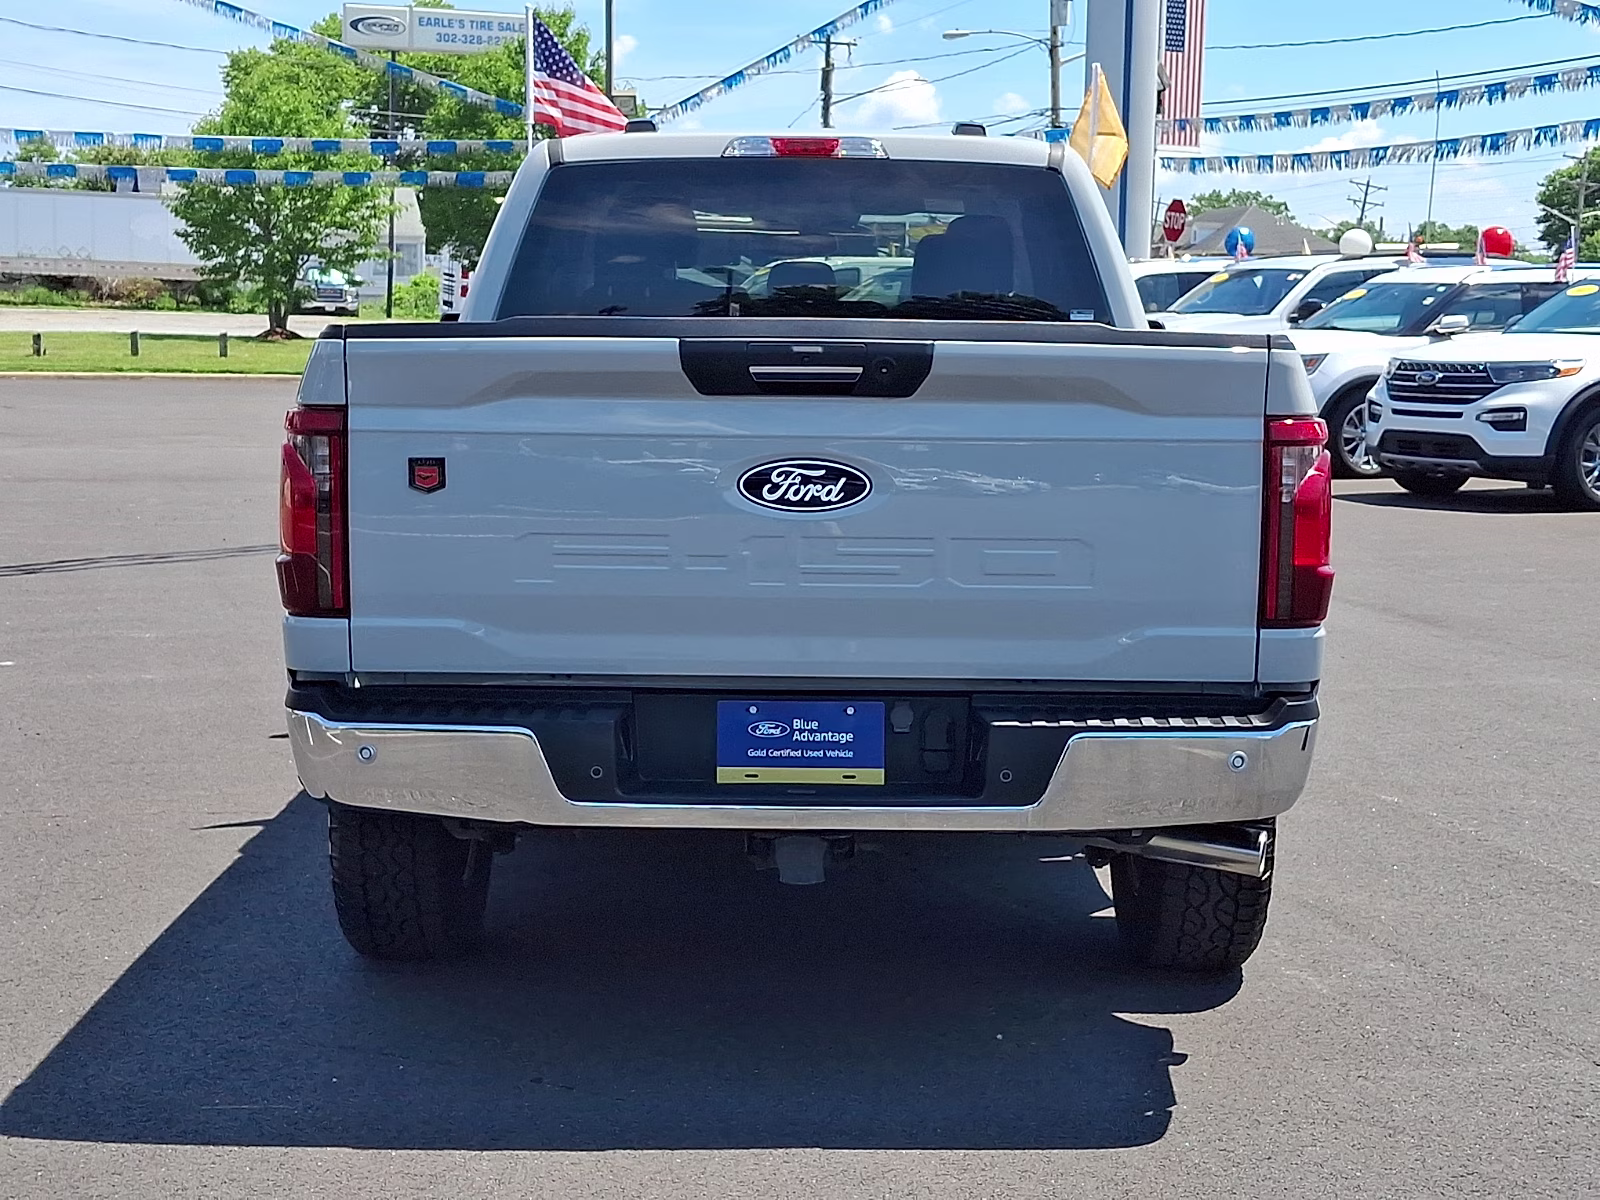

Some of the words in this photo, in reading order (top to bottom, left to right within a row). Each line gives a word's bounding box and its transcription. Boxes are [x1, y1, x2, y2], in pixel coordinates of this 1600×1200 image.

[418, 16, 466, 29] EARLE'S
[469, 20, 494, 31] TIRE
[1164, 211, 1185, 230] STOP
[762, 467, 847, 502] Ford
[755, 723, 783, 735] Ford
[792, 718, 819, 730] Blue
[792, 731, 854, 744] Advantage
[747, 749, 767, 757] Gold
[768, 749, 801, 757] Certified
[803, 749, 824, 758] Used
[825, 750, 854, 758] Vehicle
